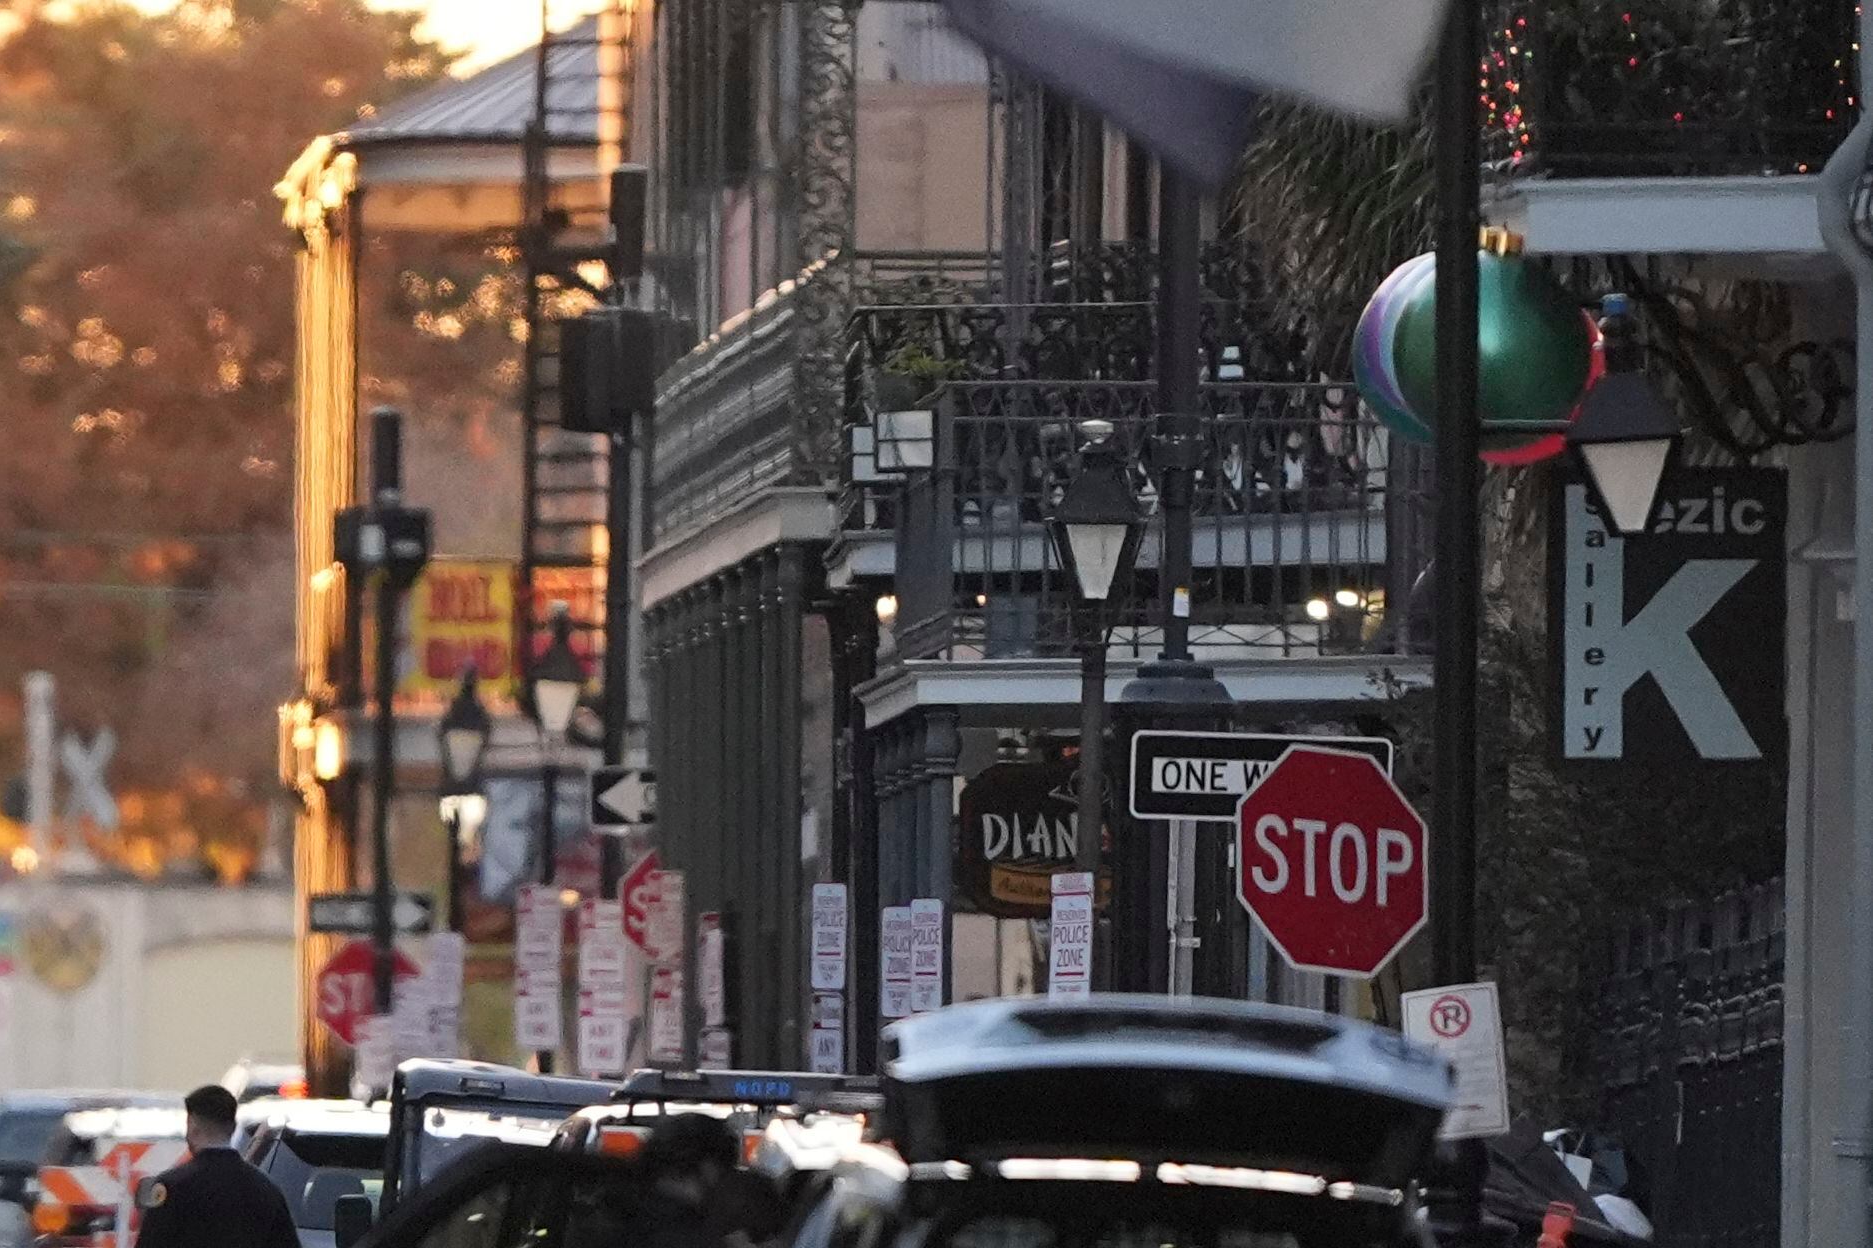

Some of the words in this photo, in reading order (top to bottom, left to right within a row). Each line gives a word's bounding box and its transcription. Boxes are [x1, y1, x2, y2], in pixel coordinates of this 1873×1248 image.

[1161, 760, 1228, 791] ONE
[982, 811, 1078, 860] DIAN
[1251, 813, 1414, 908] STOP
[884, 935, 911, 953] POLIC
[912, 928, 939, 945] POLICE
[1053, 926, 1089, 944] POLICE
[1056, 948, 1084, 967] ZONE
